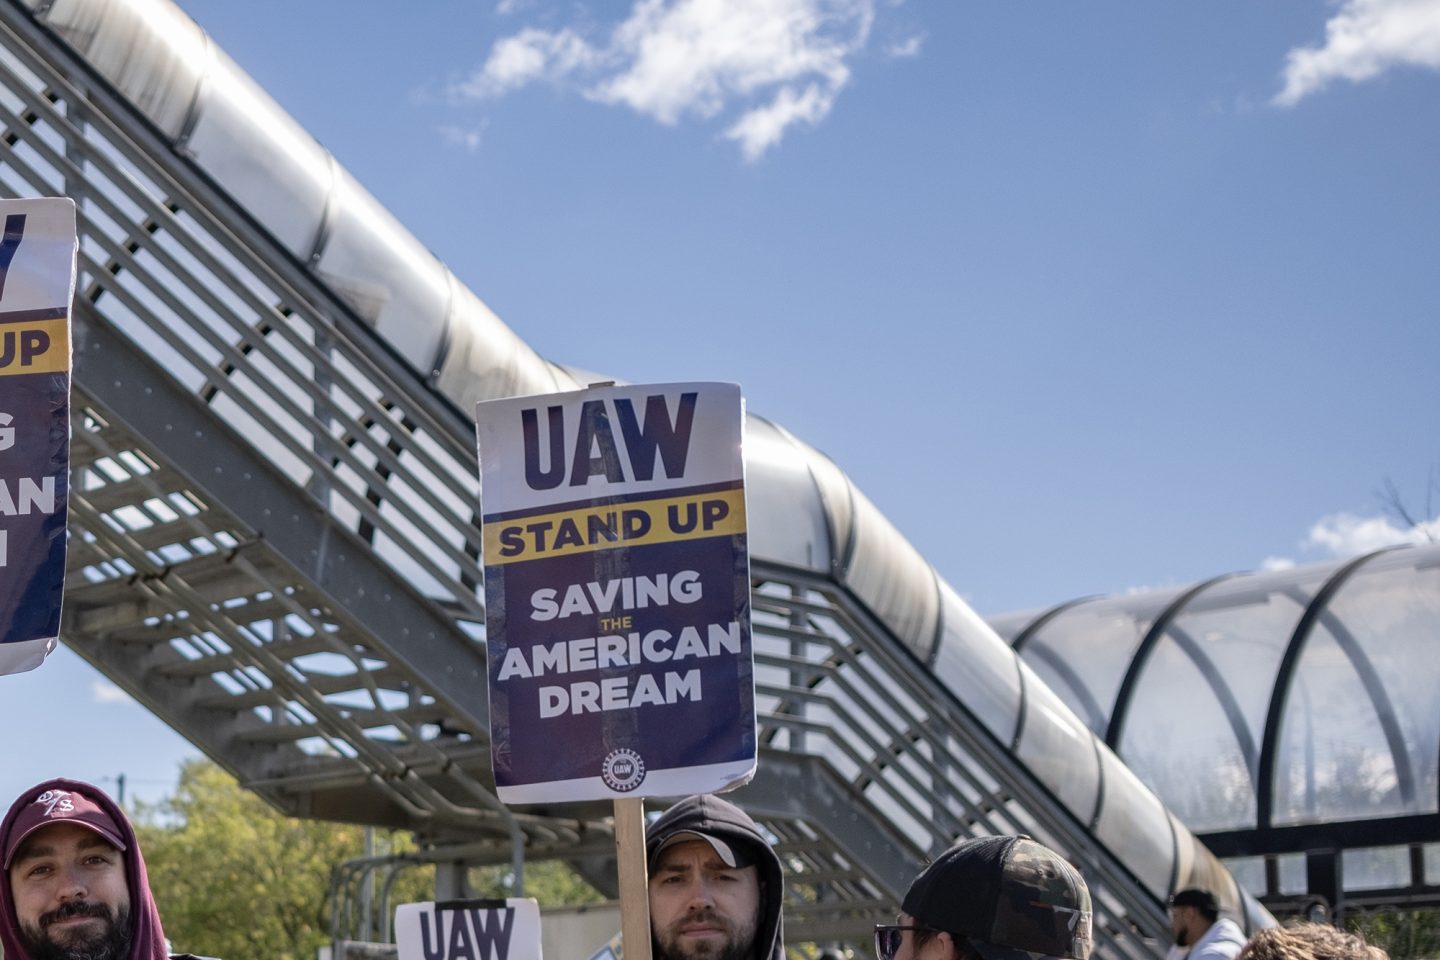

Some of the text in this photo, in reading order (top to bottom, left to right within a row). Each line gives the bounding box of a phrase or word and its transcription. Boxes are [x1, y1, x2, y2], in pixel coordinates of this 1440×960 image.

[521, 392, 699, 491] UAW
[498, 499, 730, 557] STAND UP
[530, 570, 703, 622] SAVING
[600, 615, 633, 632] THE
[497, 621, 742, 681] AMERICAN
[538, 669, 703, 719] DREAM
